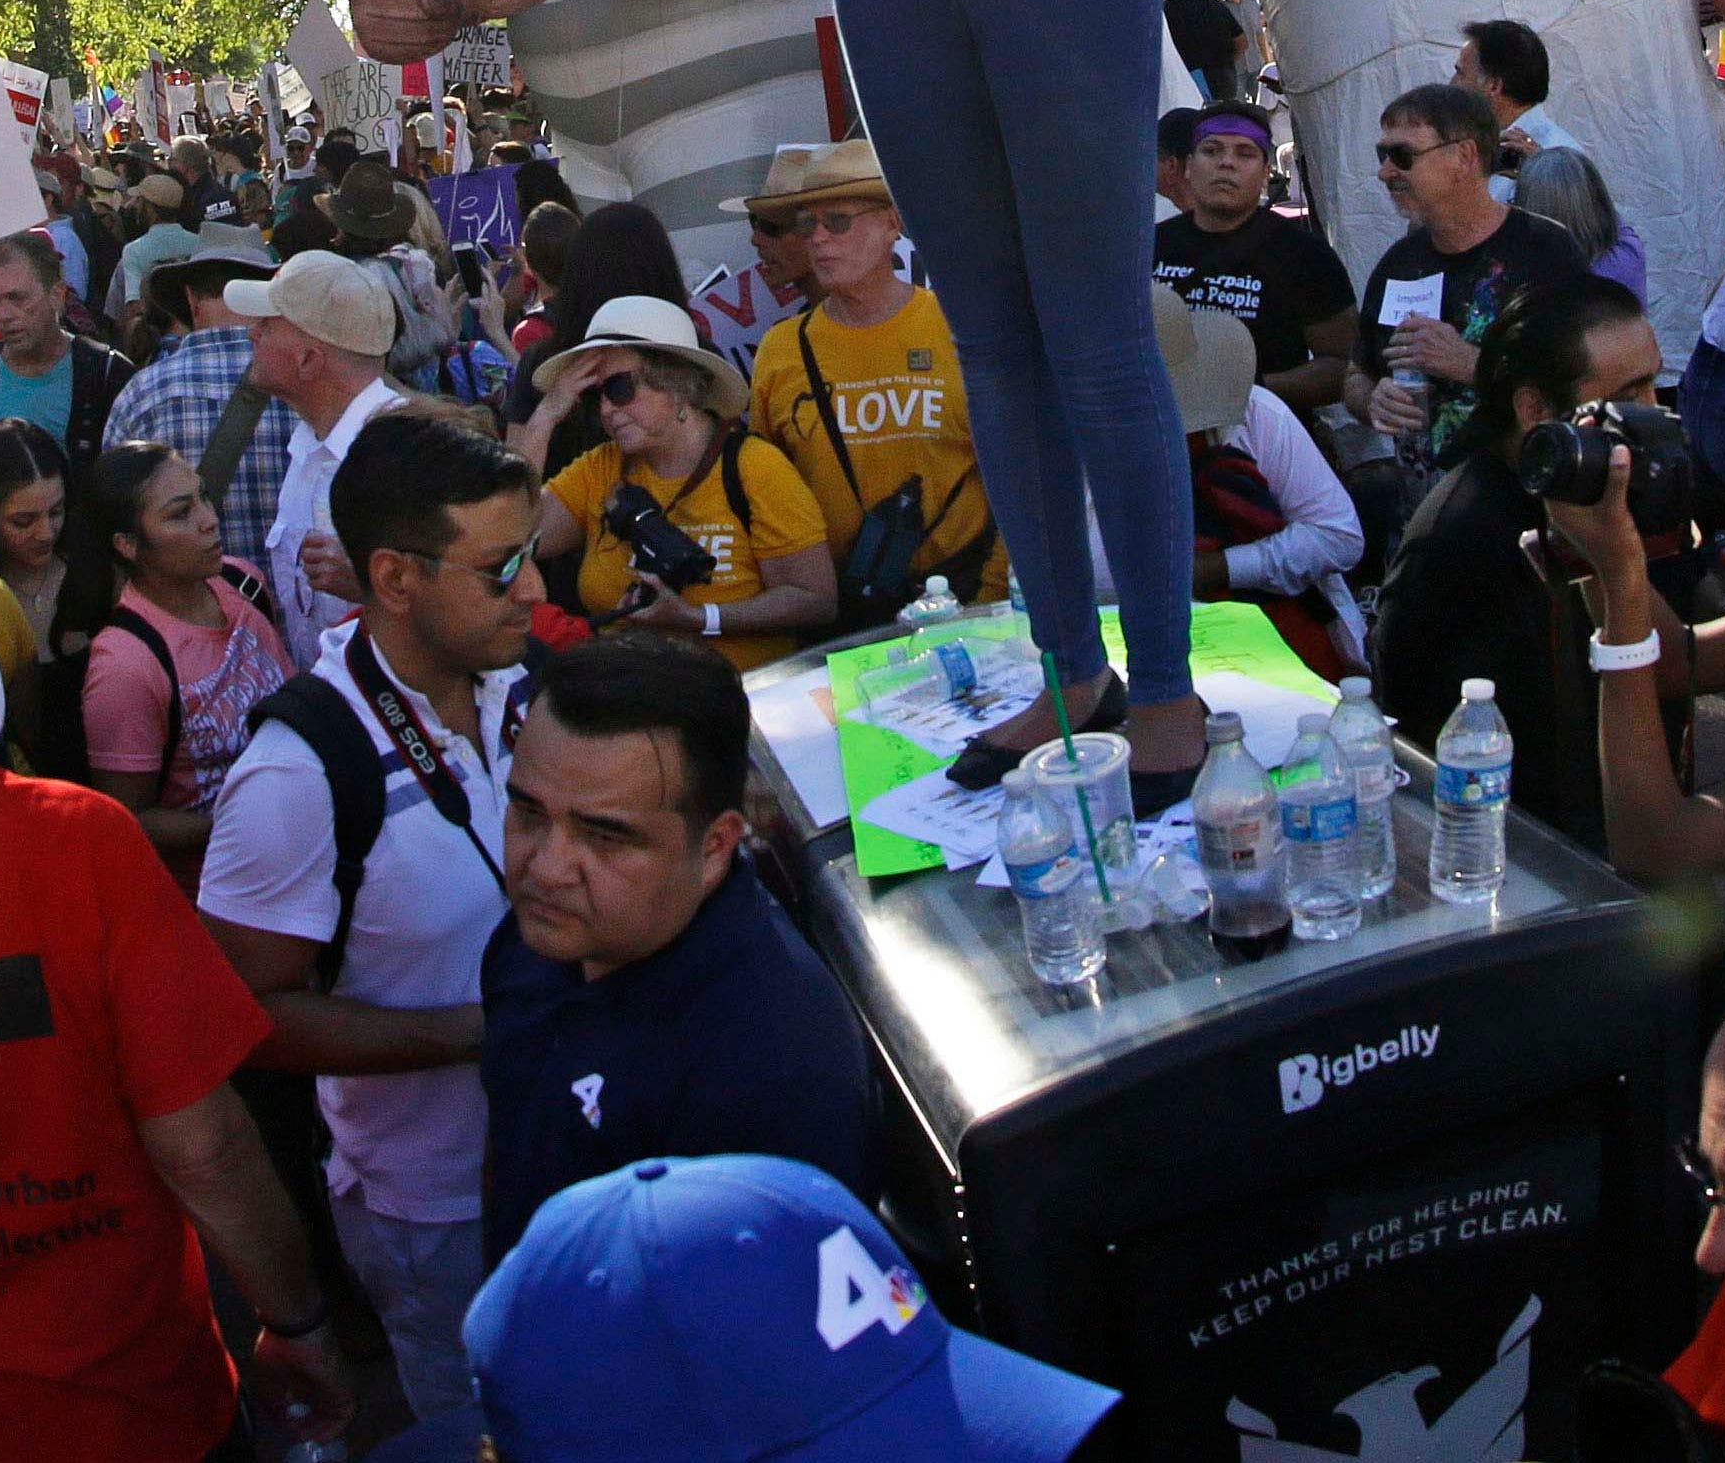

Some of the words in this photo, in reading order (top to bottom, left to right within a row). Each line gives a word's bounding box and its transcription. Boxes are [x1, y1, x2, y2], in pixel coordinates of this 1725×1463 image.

[443, 58, 503, 84] MATTER
[460, 46, 495, 61] LIES
[359, 63, 388, 90] ARE
[345, 89, 392, 122] GOOD
[1208, 286, 1260, 308] People
[837, 388, 944, 433] LOVE
[1278, 1022, 1440, 1114] Bigbelly
[1220, 1241, 1339, 1302] THANKS
[1351, 1215, 1403, 1249] FOR
[1413, 1180, 1531, 1226] HELPING
[816, 1226, 912, 1352] 4
[1190, 1292, 1273, 1349] KEEP
[1285, 1260, 1353, 1306] OUR
[1365, 1225, 1448, 1272] NEST
[1458, 1201, 1570, 1242] CLEAN.
